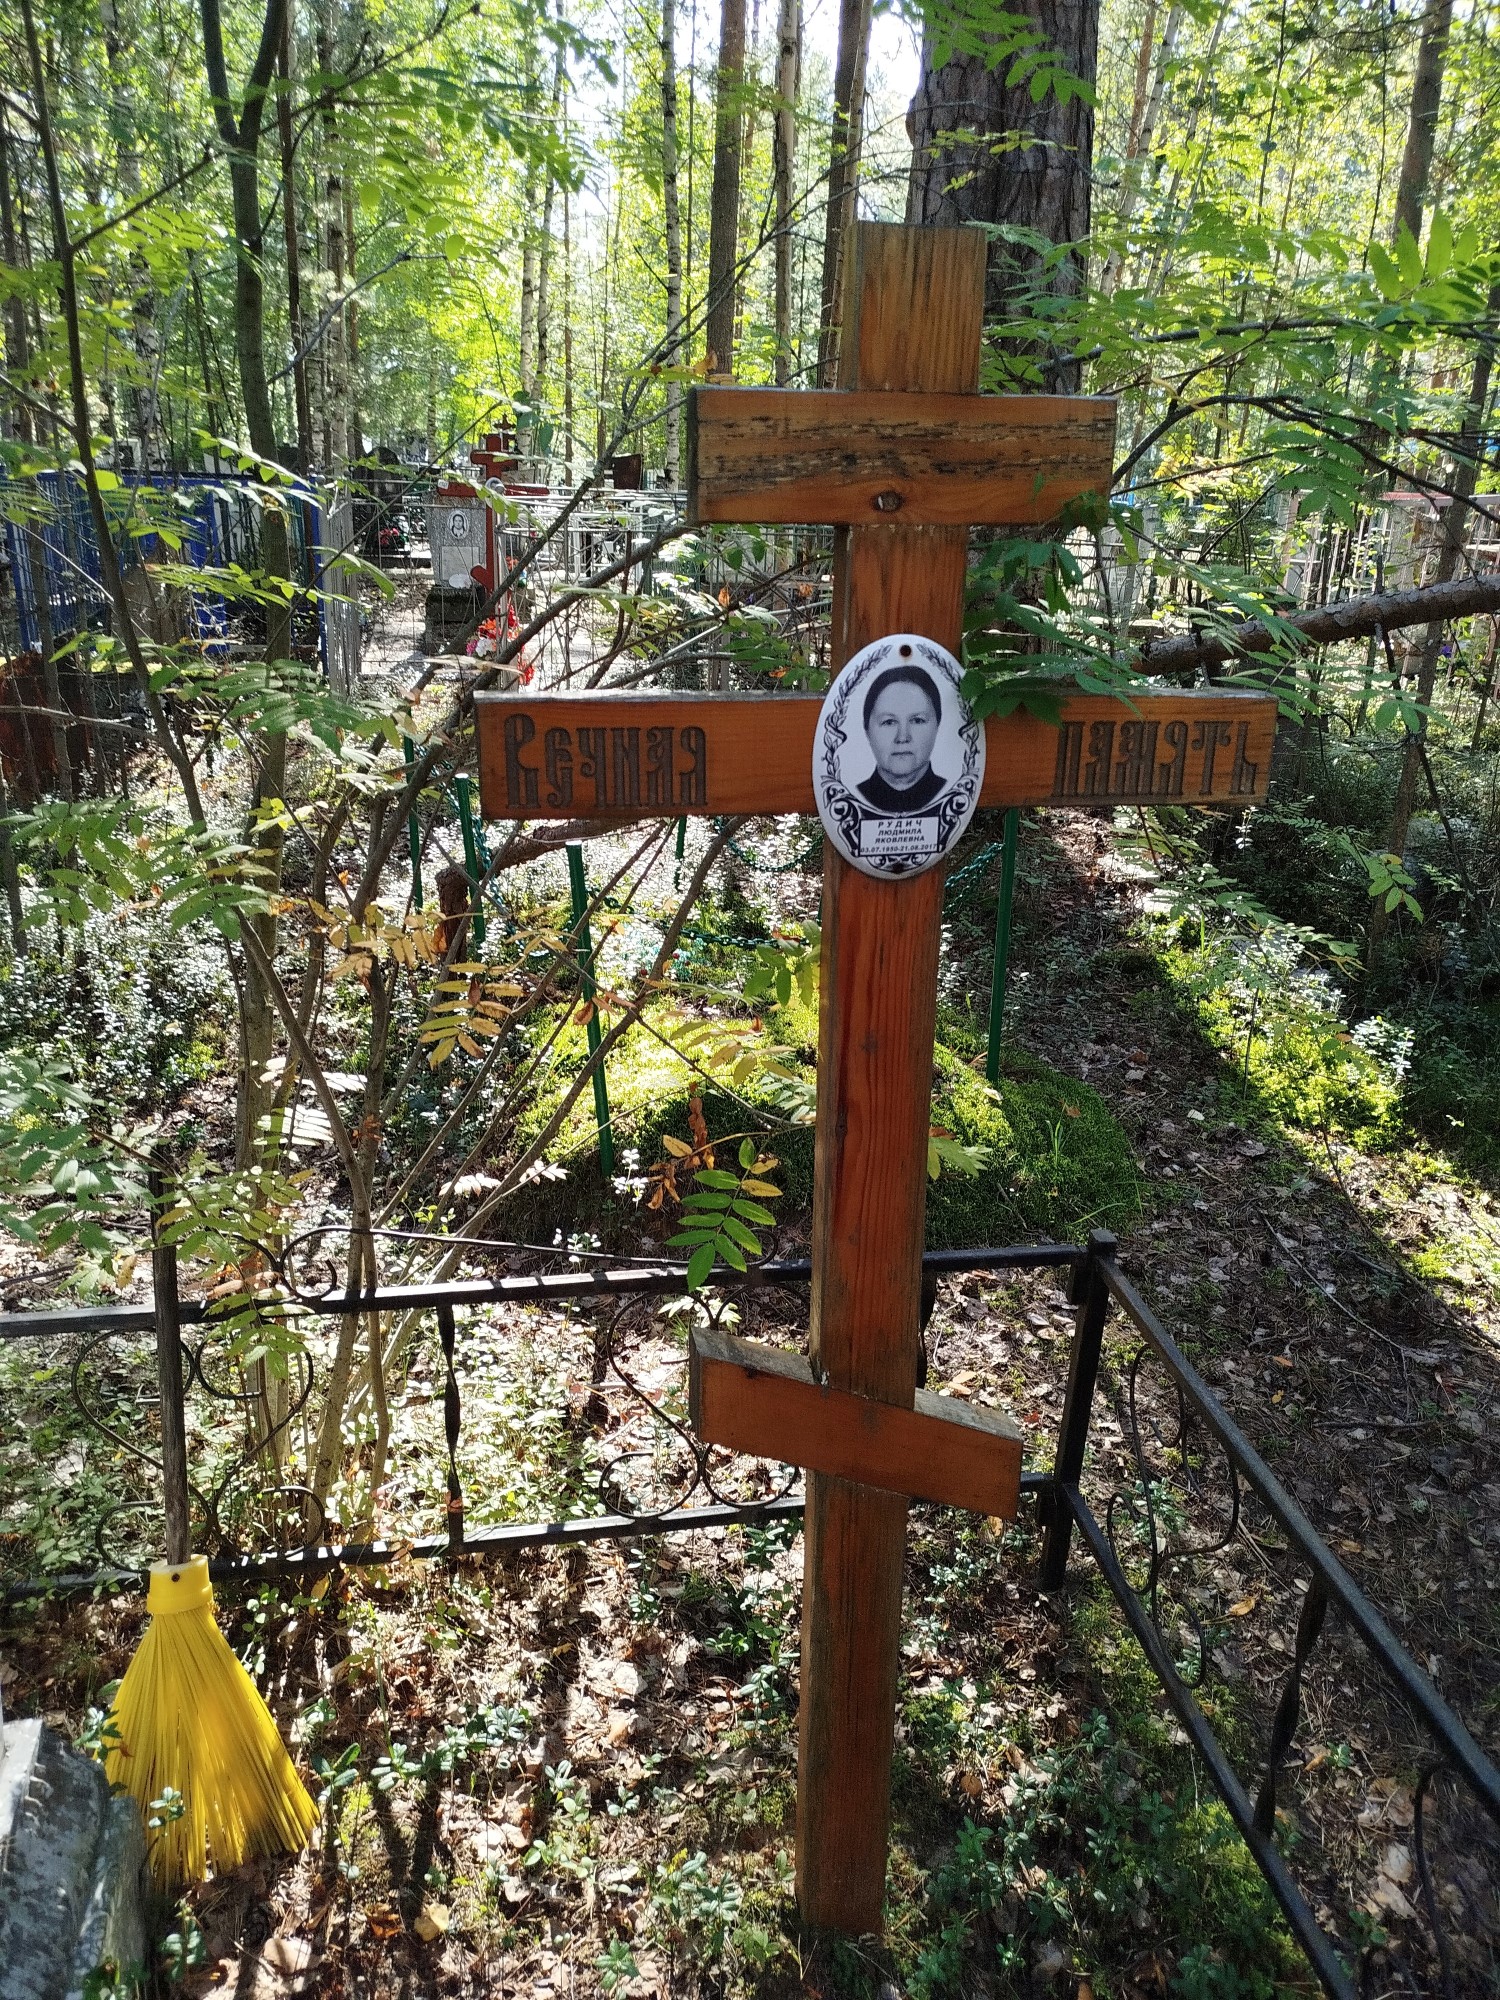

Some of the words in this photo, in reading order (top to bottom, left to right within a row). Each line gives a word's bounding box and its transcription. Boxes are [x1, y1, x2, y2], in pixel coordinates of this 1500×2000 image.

[878, 820, 922, 828] РУДИЧ
[878, 828, 922, 836] ЛЮДМИЛА
[875, 835, 925, 844] ЯКОВЛЕВНА
